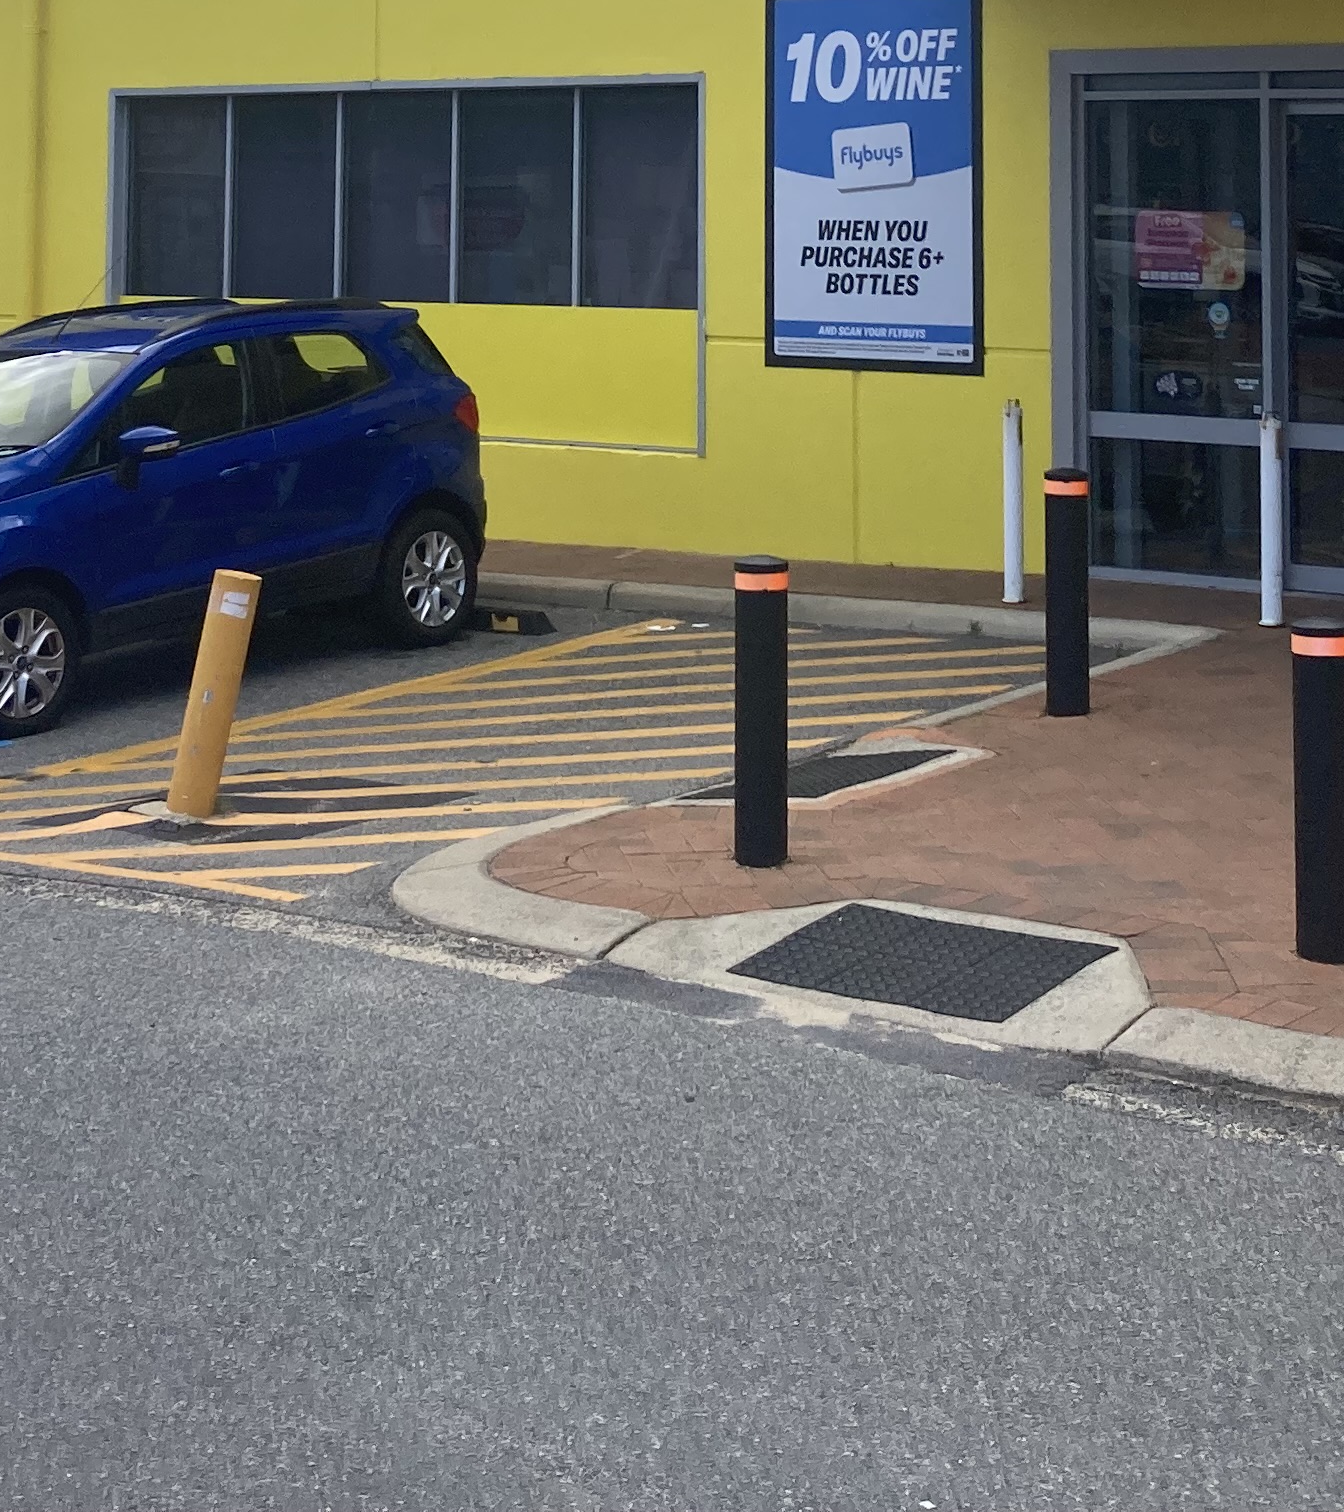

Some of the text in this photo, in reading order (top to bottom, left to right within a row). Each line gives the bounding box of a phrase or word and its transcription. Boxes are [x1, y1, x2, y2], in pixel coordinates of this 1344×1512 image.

[895, 28, 958, 63] OFF
[840, 144, 904, 170] flybuys
[818, 219, 929, 242] WHEN YOU
[800, 246, 945, 269] PURCHASE 6+
[825, 273, 920, 296] BOTTLES
[818, 325, 926, 339] AND SCAN YOUR FLYBUYS
